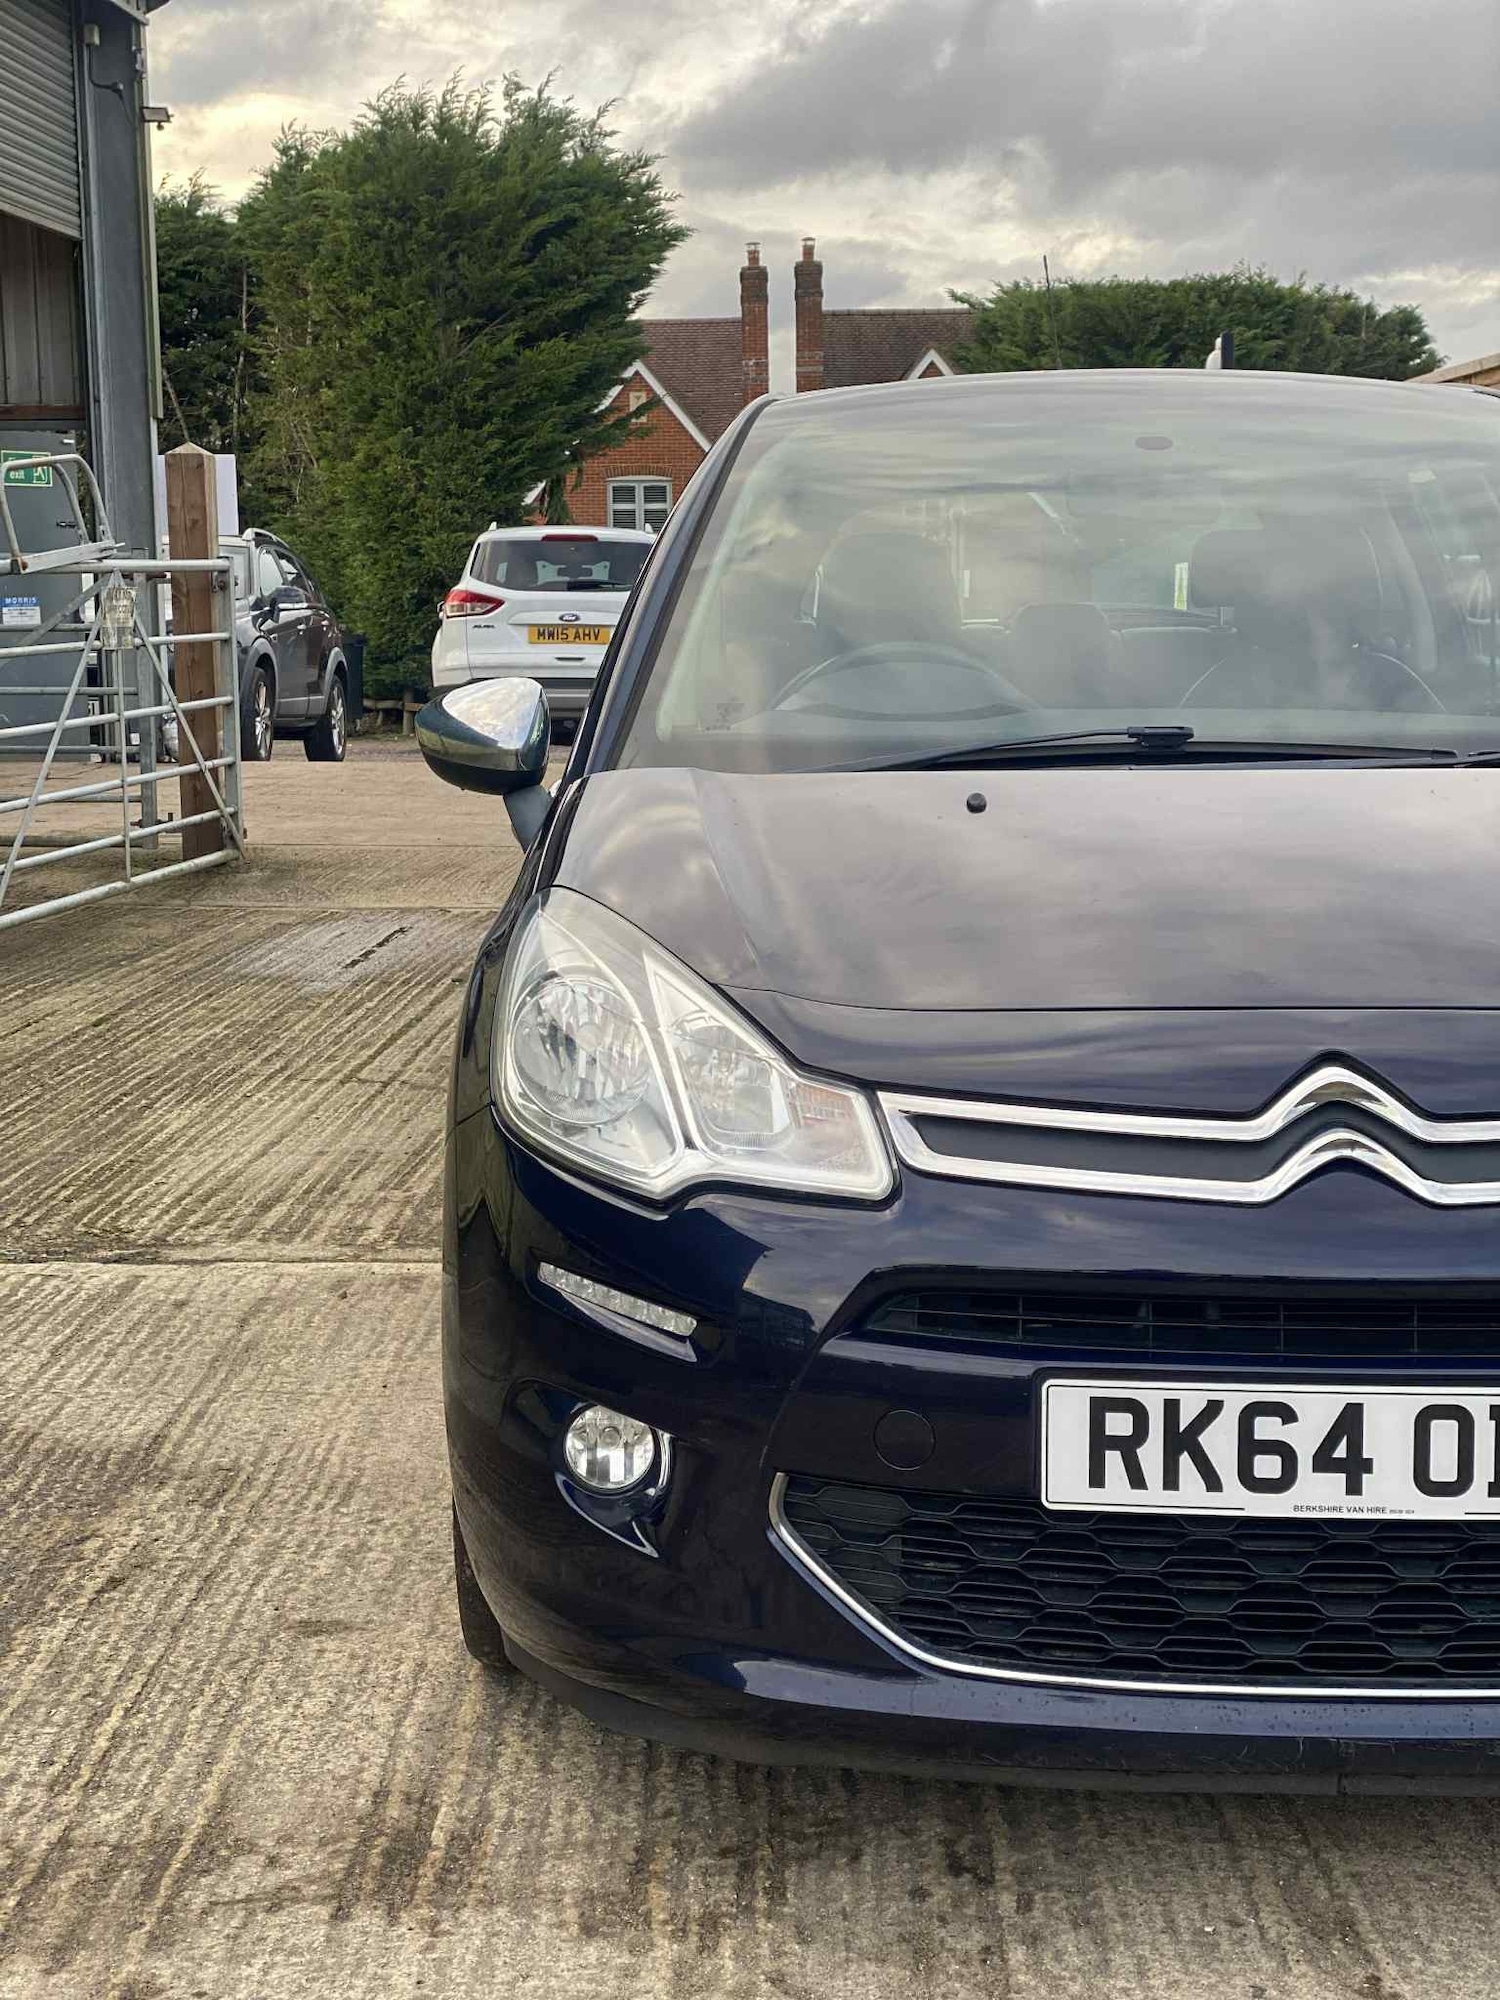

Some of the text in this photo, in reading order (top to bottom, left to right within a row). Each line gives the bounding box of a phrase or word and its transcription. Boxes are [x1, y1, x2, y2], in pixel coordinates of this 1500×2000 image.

[537, 628, 600, 641] MW15 AHV
[1088, 1396, 1500, 1497] RK64 O
[1293, 1504, 1345, 1514] BERKSHIRE
[1346, 1505, 1365, 1514] VAN
[1366, 1506, 1388, 1515] HIRE
